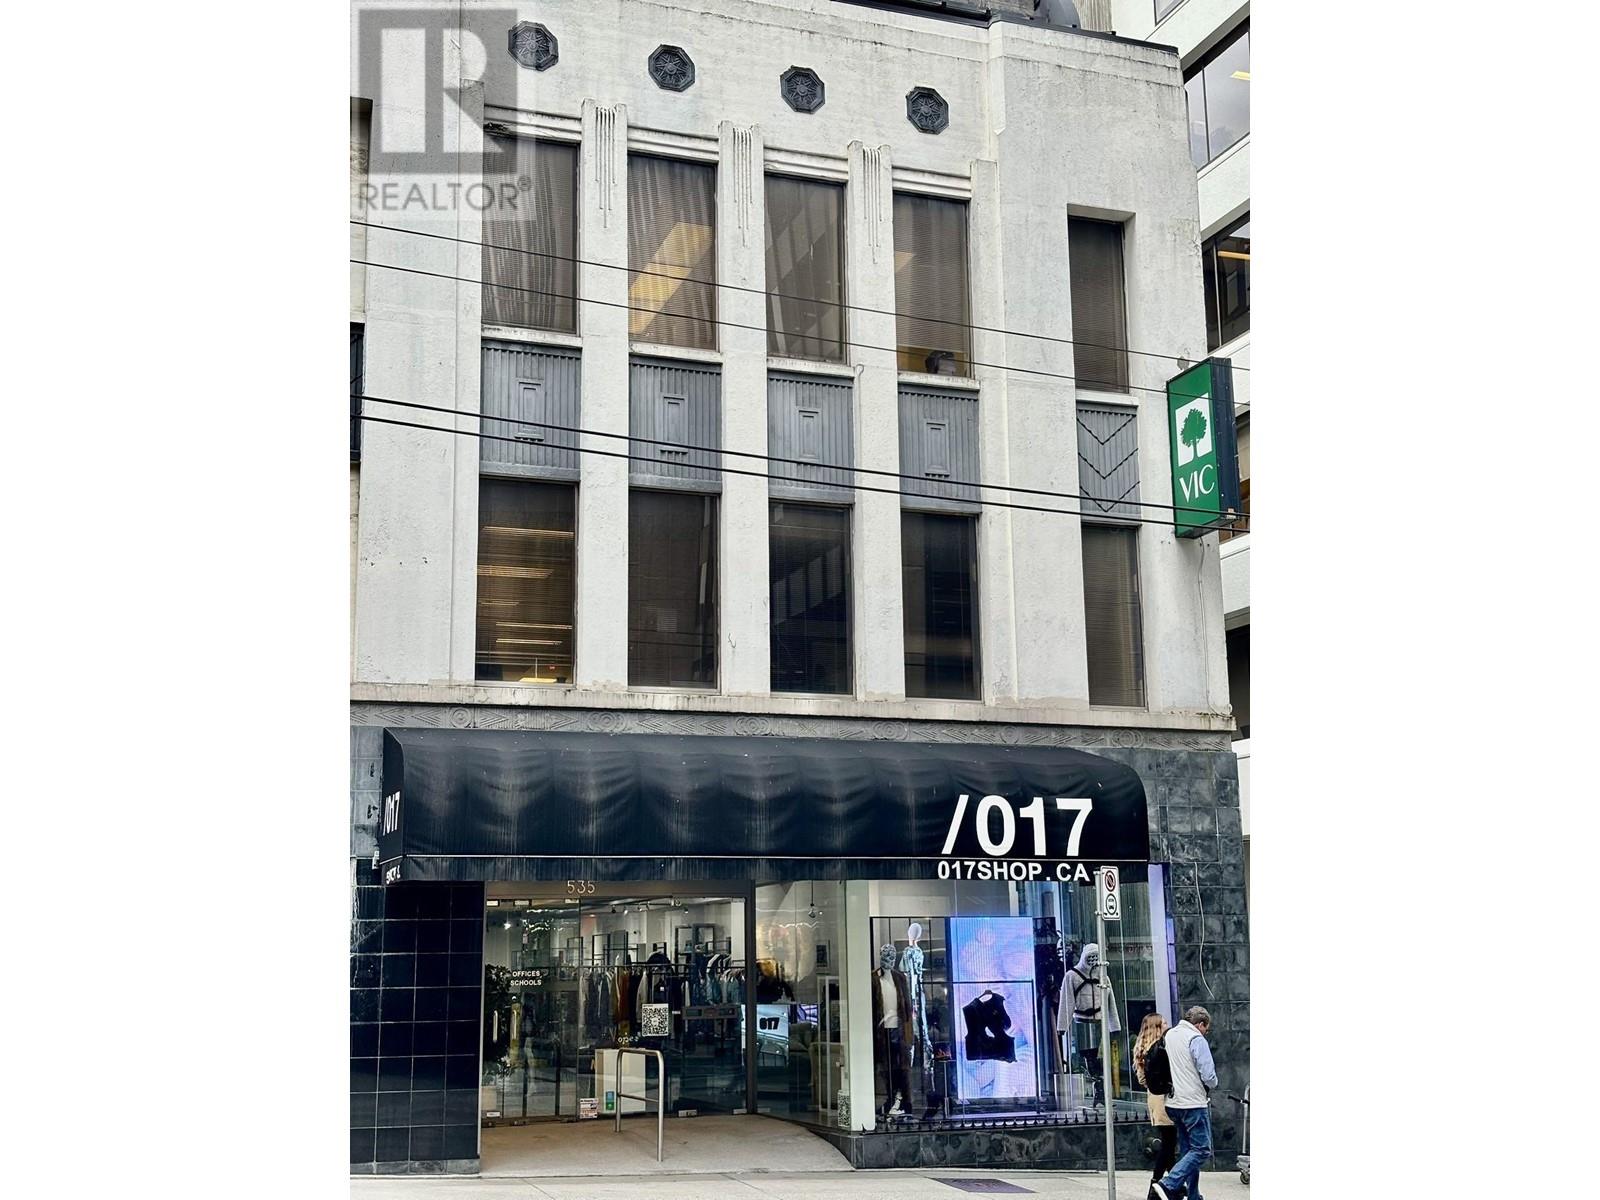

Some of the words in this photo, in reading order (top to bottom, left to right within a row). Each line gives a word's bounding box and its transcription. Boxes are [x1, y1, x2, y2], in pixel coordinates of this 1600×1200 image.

[1179, 464, 1215, 503] VIC
[941, 794, 1093, 857] /017
[567, 880, 596, 894] 535
